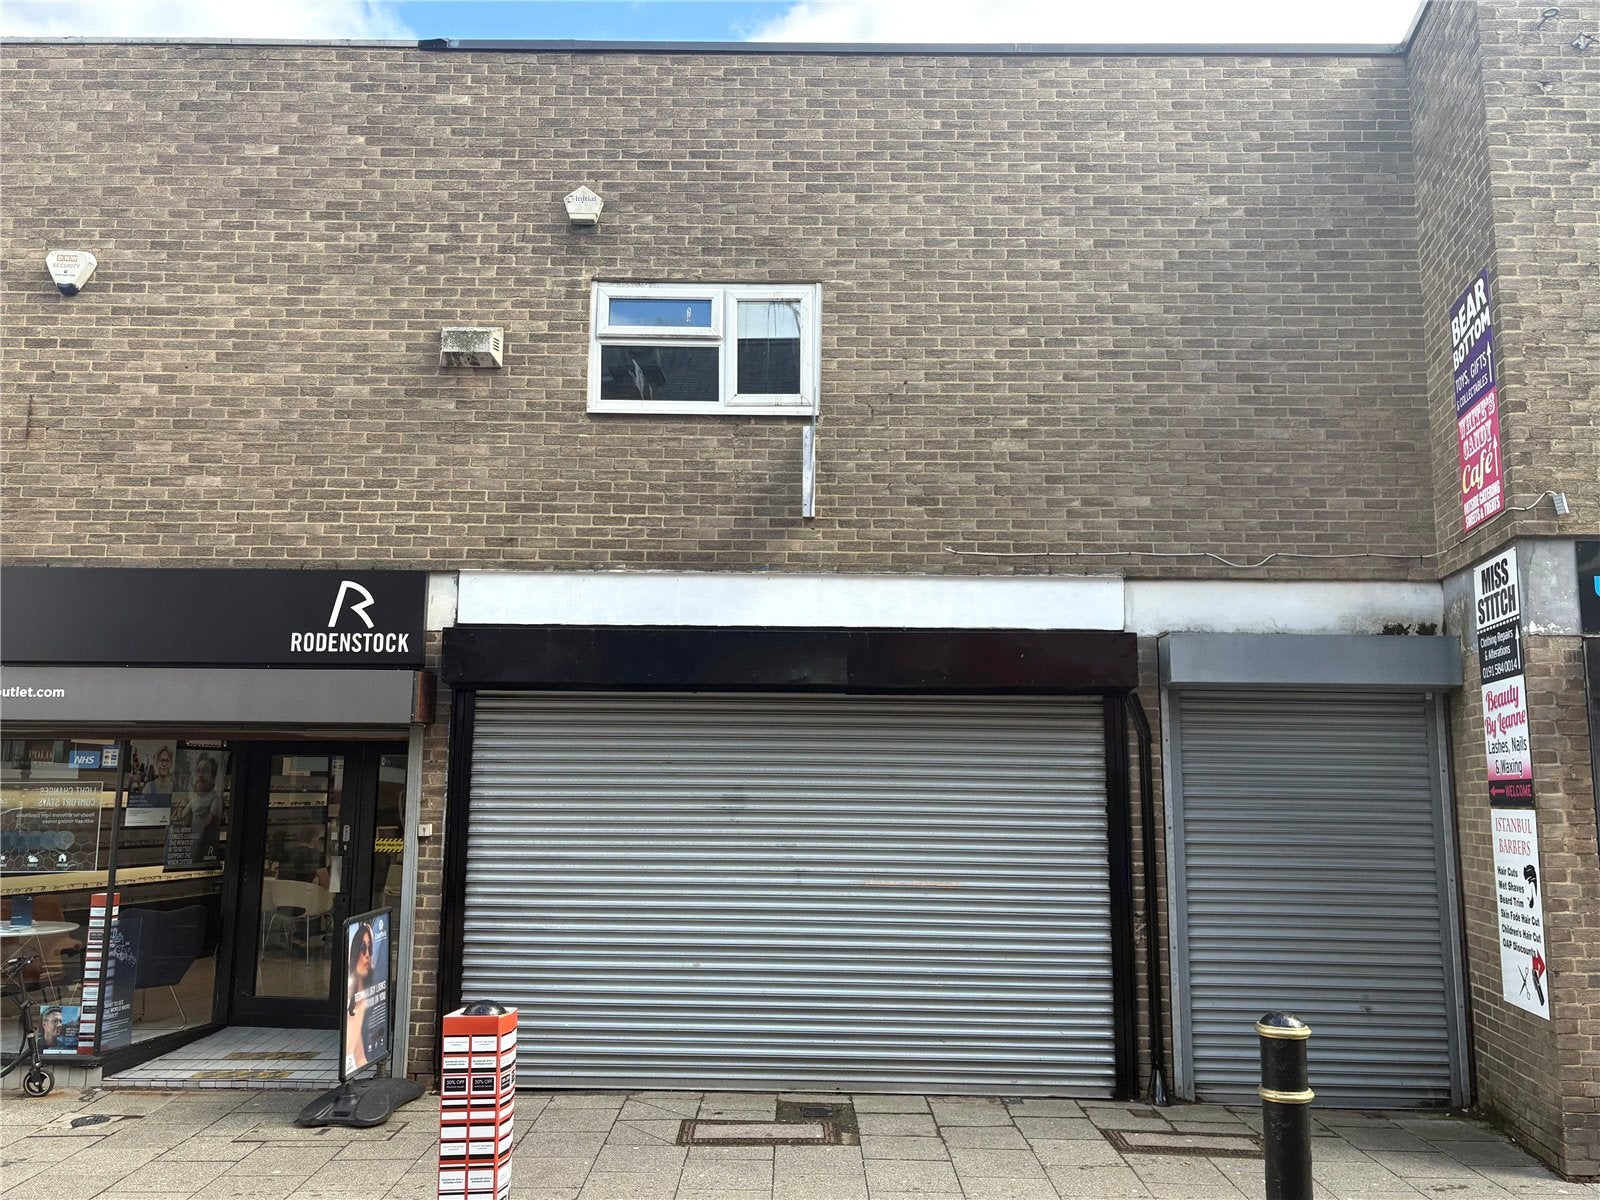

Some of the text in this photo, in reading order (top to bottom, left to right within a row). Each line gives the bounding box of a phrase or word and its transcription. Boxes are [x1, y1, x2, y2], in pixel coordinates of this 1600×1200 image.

[1451, 278, 1487, 347] BEAR
[1453, 305, 1490, 371] BOTTOM
[1470, 351, 1487, 378] GIFTS
[1462, 442, 1492, 494] Café
[1481, 558, 1509, 595] MISS
[1478, 584, 1516, 625] STITCH
[291, 632, 409, 653] RODENSTOCK
[1480, 628, 1513, 648] Clothing Repairs
[1488, 645, 1511, 660] Alterations
[0, 686, 65, 698] utlet.com
[1486, 684, 1519, 712] Beauty
[1485, 709, 1526, 739] By Leanne
[1488, 736, 1527, 754] Lashes, Nails
[73, 755, 95, 764] NHS
[1500, 758, 1523, 776] Waxing
[1505, 784, 1532, 797] WELCOME
[1495, 817, 1532, 834] ISTANBUL
[1498, 838, 1531, 856] BARBERS
[1497, 866, 1518, 877] Hair Cuts
[1498, 880, 1525, 893] Wet Shaves
[1499, 894, 1524, 908] Beard Trim
[1500, 909, 1541, 927] Skin Fade Hair Cut
[1502, 923, 1542, 943] Children's Hair Cut
[1502, 939, 1536, 957] OAP Discounts
[375, 980, 386, 993] LOOKS
